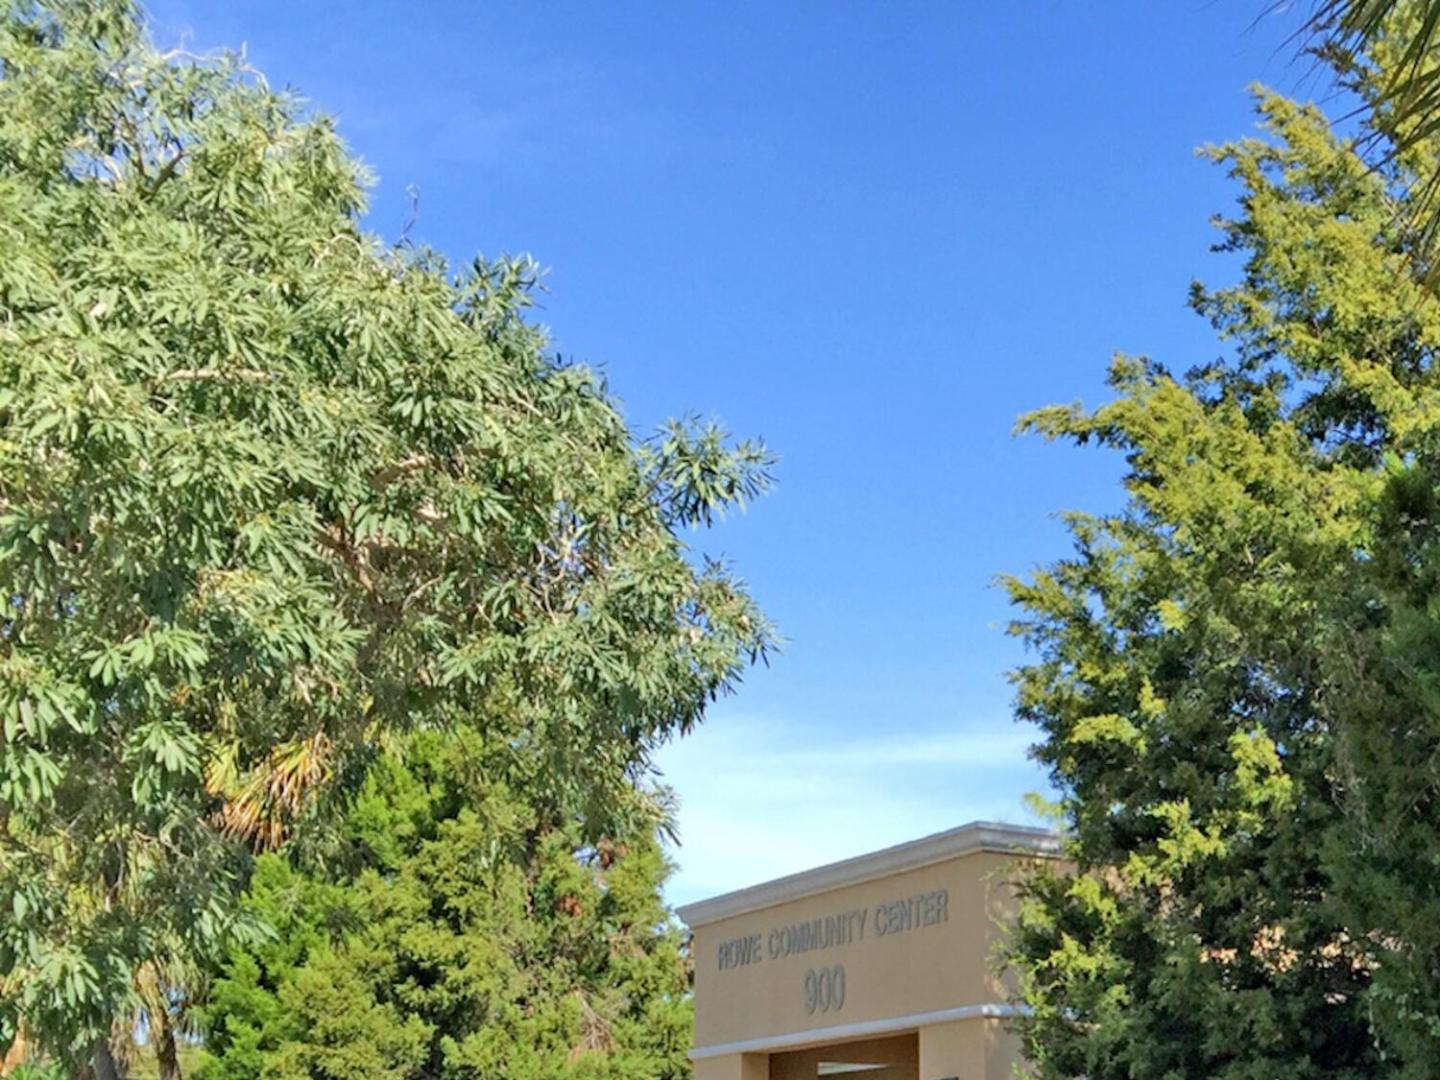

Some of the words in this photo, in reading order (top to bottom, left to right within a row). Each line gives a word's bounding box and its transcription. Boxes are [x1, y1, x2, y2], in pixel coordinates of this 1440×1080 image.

[767, 907, 868, 960] COMMUNITY
[875, 888, 949, 937] CENTER
[804, 963, 846, 1016] 900
